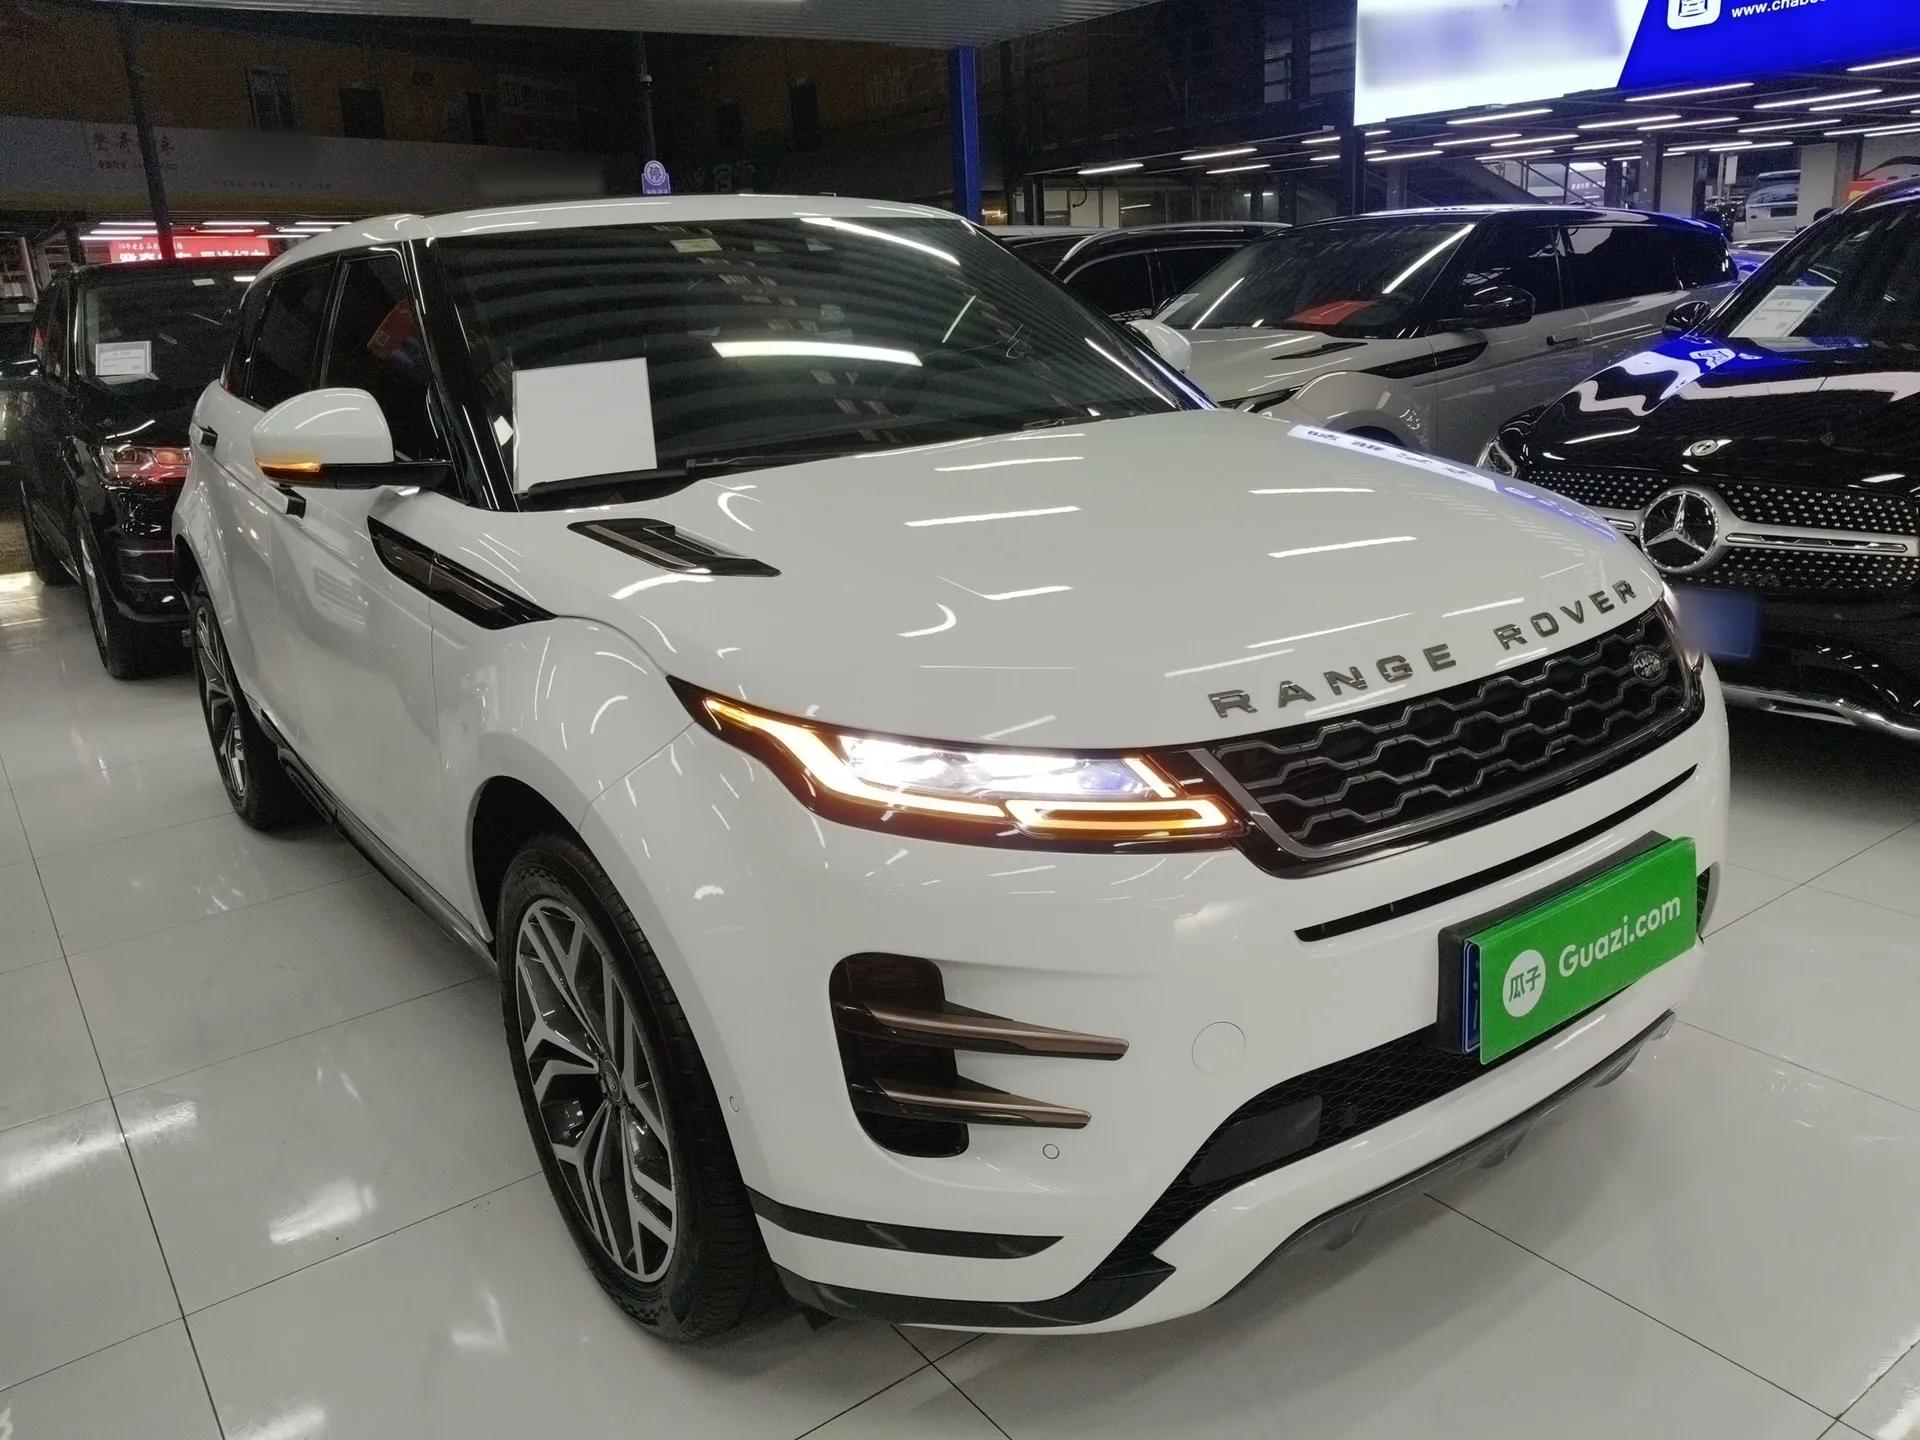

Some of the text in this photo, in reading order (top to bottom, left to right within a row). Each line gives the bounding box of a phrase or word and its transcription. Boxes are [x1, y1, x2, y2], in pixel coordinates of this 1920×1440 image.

[1207, 579, 1637, 719] RANGE ROVER
[1558, 897, 1680, 977] Guazi.com
[1509, 965, 1541, 1002] 瓜子
